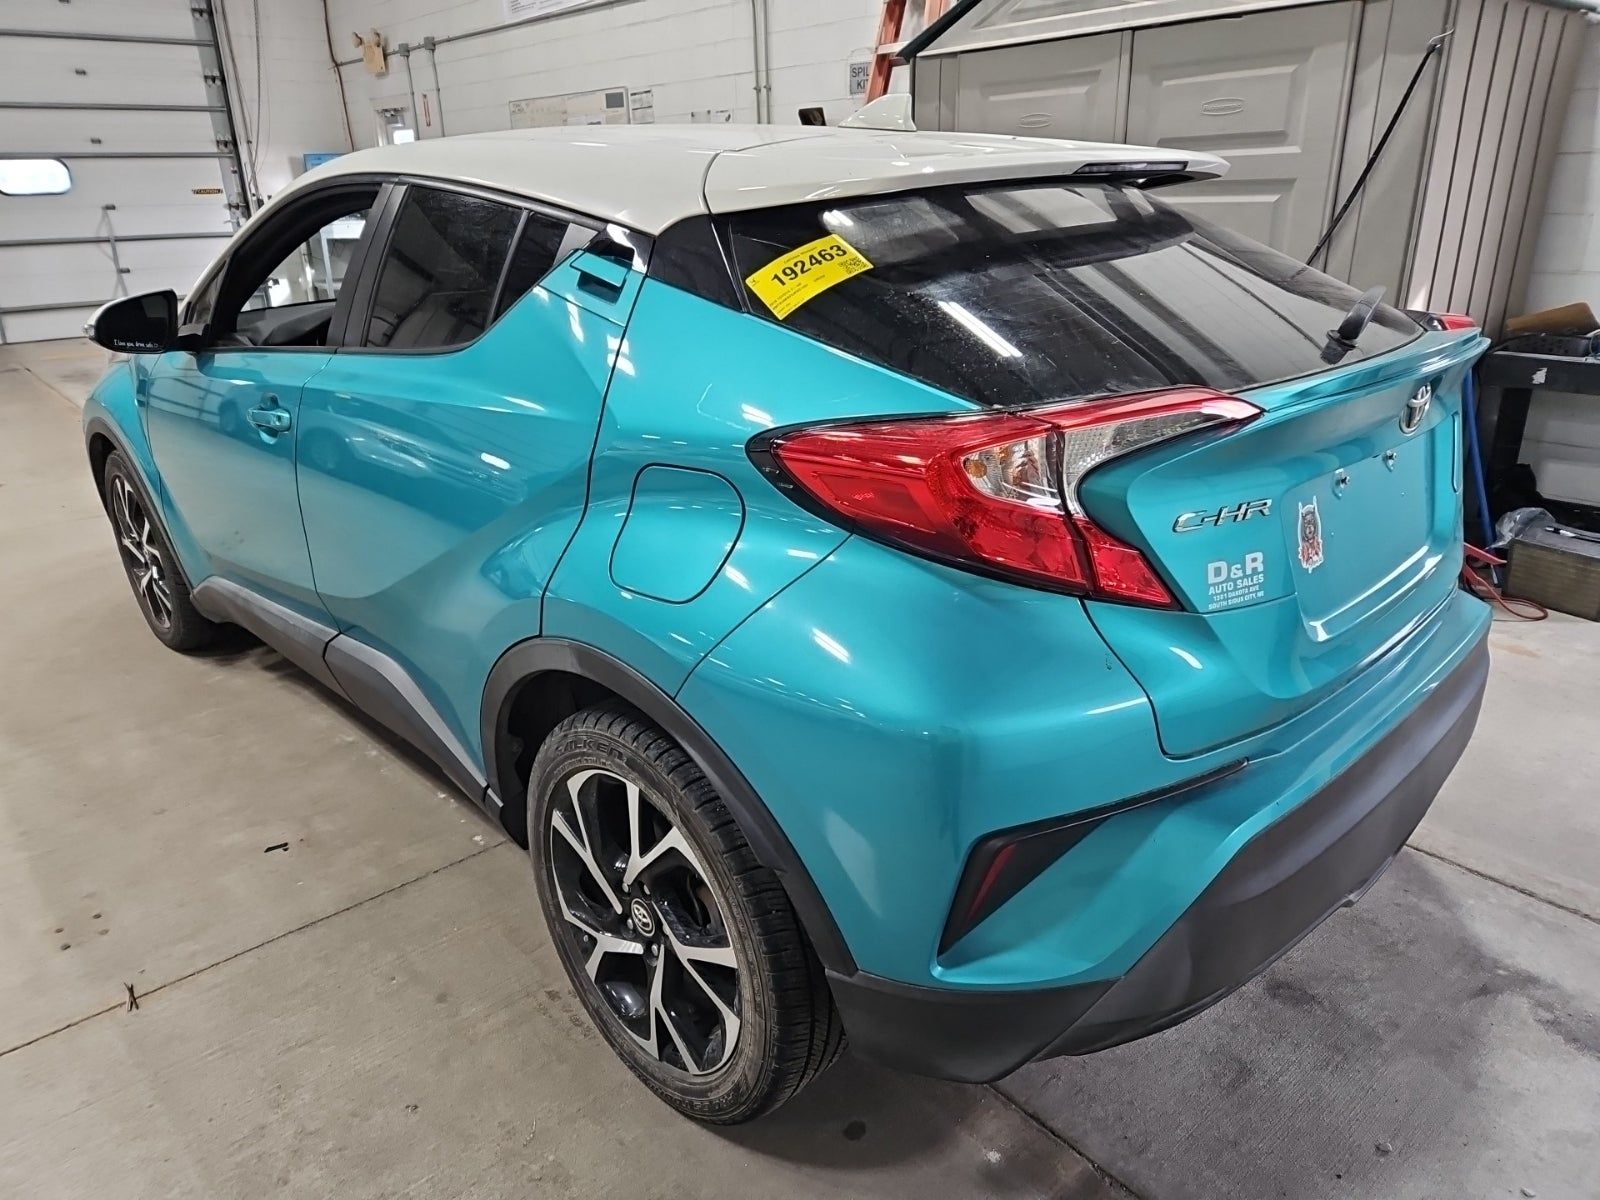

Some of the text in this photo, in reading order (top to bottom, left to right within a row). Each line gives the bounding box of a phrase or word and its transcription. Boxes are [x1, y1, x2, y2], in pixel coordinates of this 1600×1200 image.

[851, 66, 870, 78] SPIL
[770, 244, 847, 286] 192463
[1172, 498, 1272, 533] C-HR
[1208, 573, 1264, 596] AUTO SALES
[1228, 587, 1249, 599] DAKOTA
[1249, 584, 1260, 593] AVE
[1208, 599, 1228, 610] SOUTH
